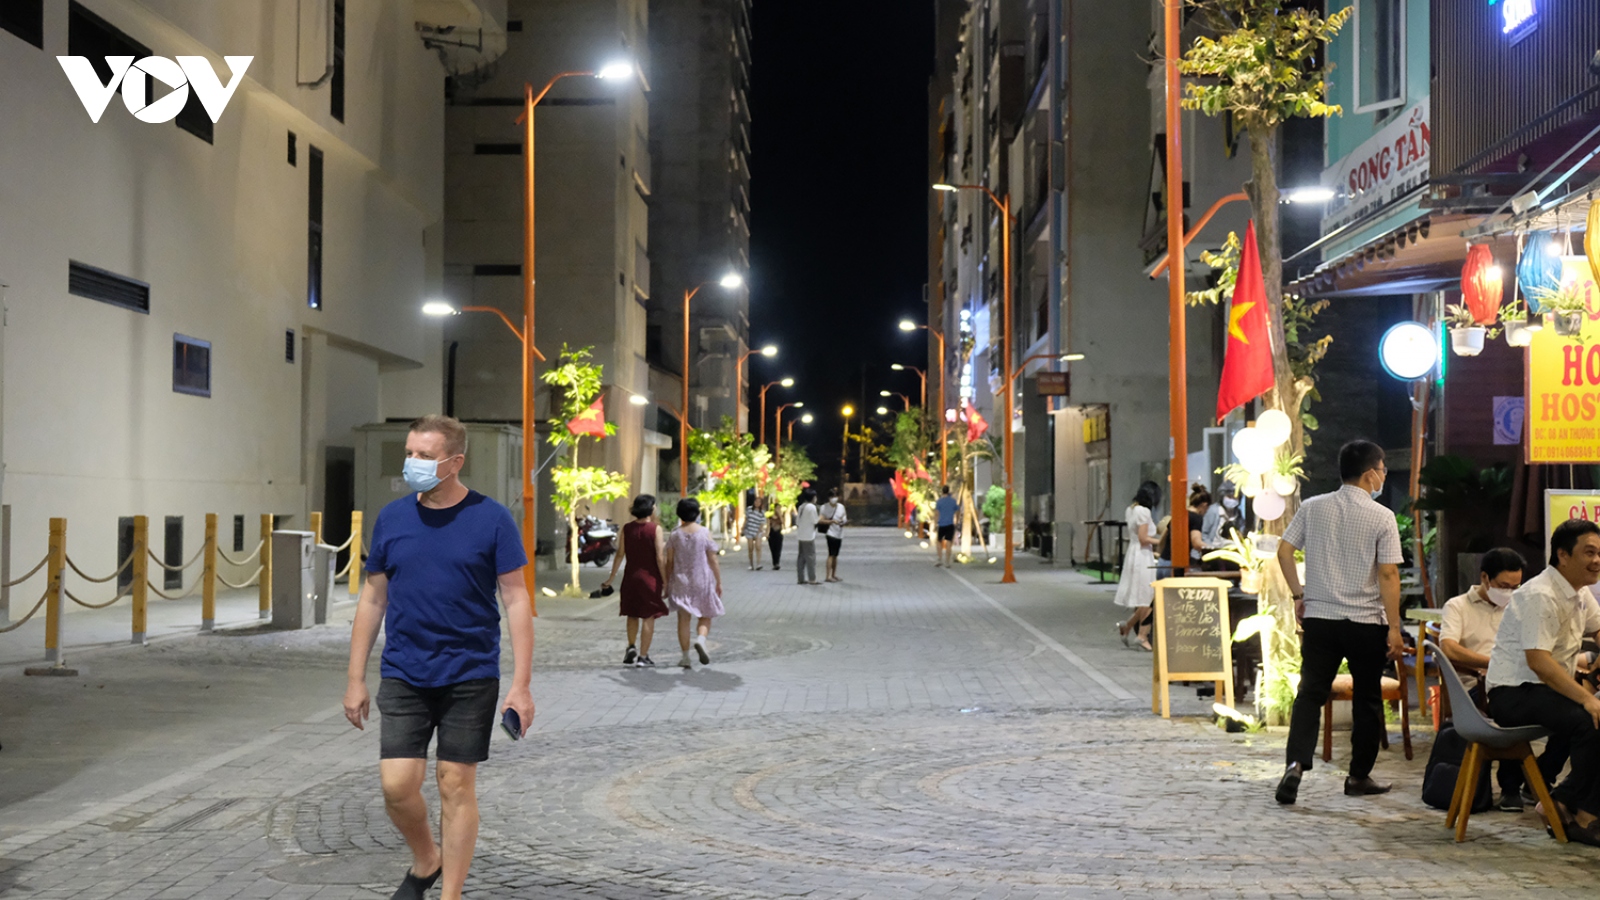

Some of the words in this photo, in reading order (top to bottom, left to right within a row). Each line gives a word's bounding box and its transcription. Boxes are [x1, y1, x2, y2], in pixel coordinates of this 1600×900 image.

[1349, 146, 1391, 196] SONG
[1541, 392, 1600, 422] HOS
[1558, 427, 1568, 440] AN
